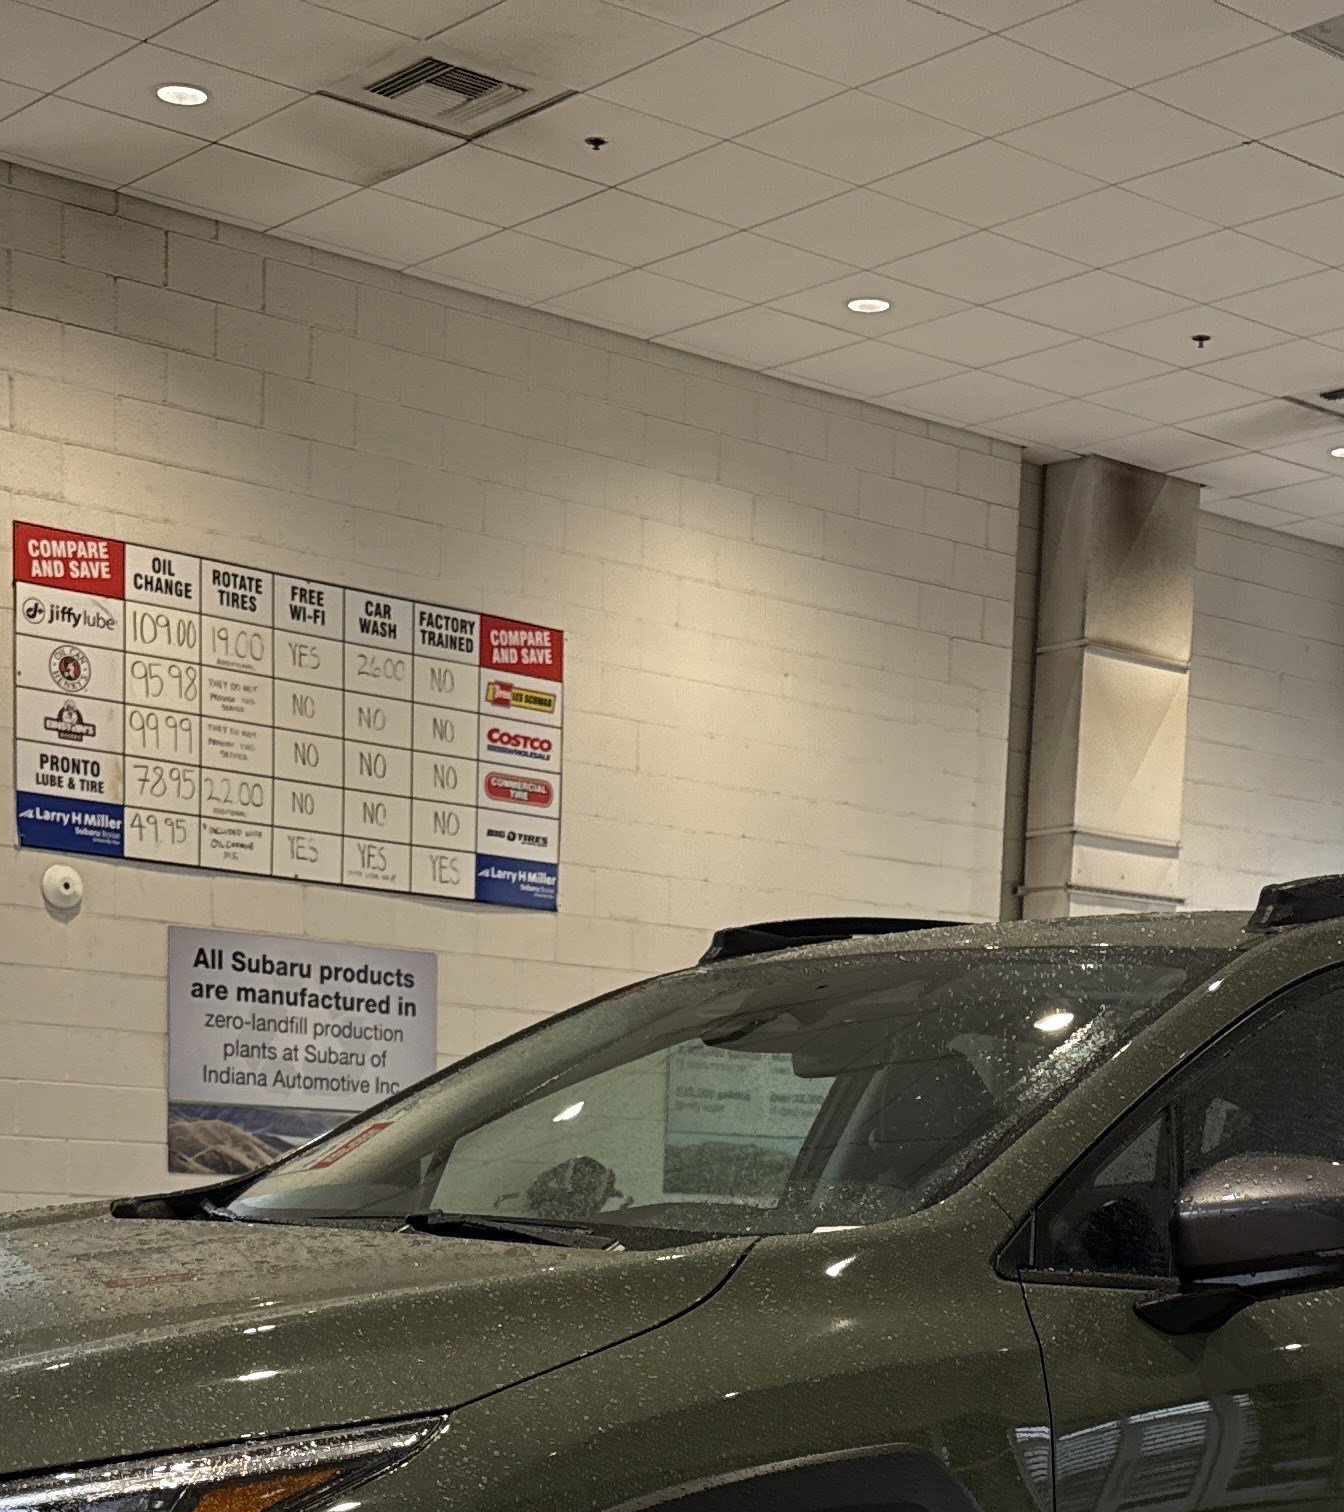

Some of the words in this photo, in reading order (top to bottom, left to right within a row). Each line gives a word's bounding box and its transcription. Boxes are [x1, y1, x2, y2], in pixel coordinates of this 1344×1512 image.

[27, 539, 110, 560] COMPARE
[31, 560, 65, 578] AND
[68, 560, 112, 579] SAVE
[152, 557, 176, 577] OIL
[133, 573, 193, 599] CHANGE
[212, 569, 264, 595] ROTATE
[217, 589, 258, 613] TIRES
[290, 585, 325, 608] FREE
[47, 603, 83, 628] jiffy
[289, 603, 326, 626] WI-FI
[364, 600, 392, 621] CAR
[419, 610, 476, 636] FACTORY
[358, 617, 397, 640] WASH
[420, 628, 474, 654] TRAINED
[489, 629, 552, 648] COMPARE
[287, 642, 321, 670] YES
[491, 647, 518, 665] AND
[520, 648, 554, 666] SAVE
[429, 667, 455, 693] NO
[291, 693, 316, 719] NO
[358, 706, 387, 732] NO
[432, 717, 455, 743] NO
[487, 728, 553, 753] COSTCO
[39, 753, 101, 778] PRONTO
[293, 741, 320, 768] NO
[358, 751, 387, 779] NO
[35, 772, 64, 788] LUBE
[67, 776, 76, 790] &
[79, 778, 105, 794] TIRE
[432, 763, 458, 790] NO
[291, 791, 315, 816] NO
[362, 801, 387, 827] NO
[35, 806, 71, 827] Larry
[71, 811, 82, 825] H
[83, 813, 123, 830] Miller
[433, 810, 460, 837] NO
[287, 834, 320, 863] YES
[356, 842, 387, 872] YES
[428, 854, 460, 886] YES
[491, 865, 518, 884] Larry
[518, 870, 527, 882] H
[193, 947, 224, 970] All
[231, 951, 312, 979] Subaru
[319, 964, 415, 989] products
[190, 981, 229, 1001] are
[236, 985, 391, 1015] manufactured
[397, 996, 417, 1017] in
[204, 1012, 308, 1035] zero-landfill
[313, 1020, 404, 1042] production
[223, 1039, 278, 1061] plants
[281, 1045, 299, 1062] at
[304, 1044, 366, 1067] Subaru
[370, 1050, 388, 1068] of
[202, 1064, 268, 1087] Indiana
[272, 1069, 370, 1094] Automotive
